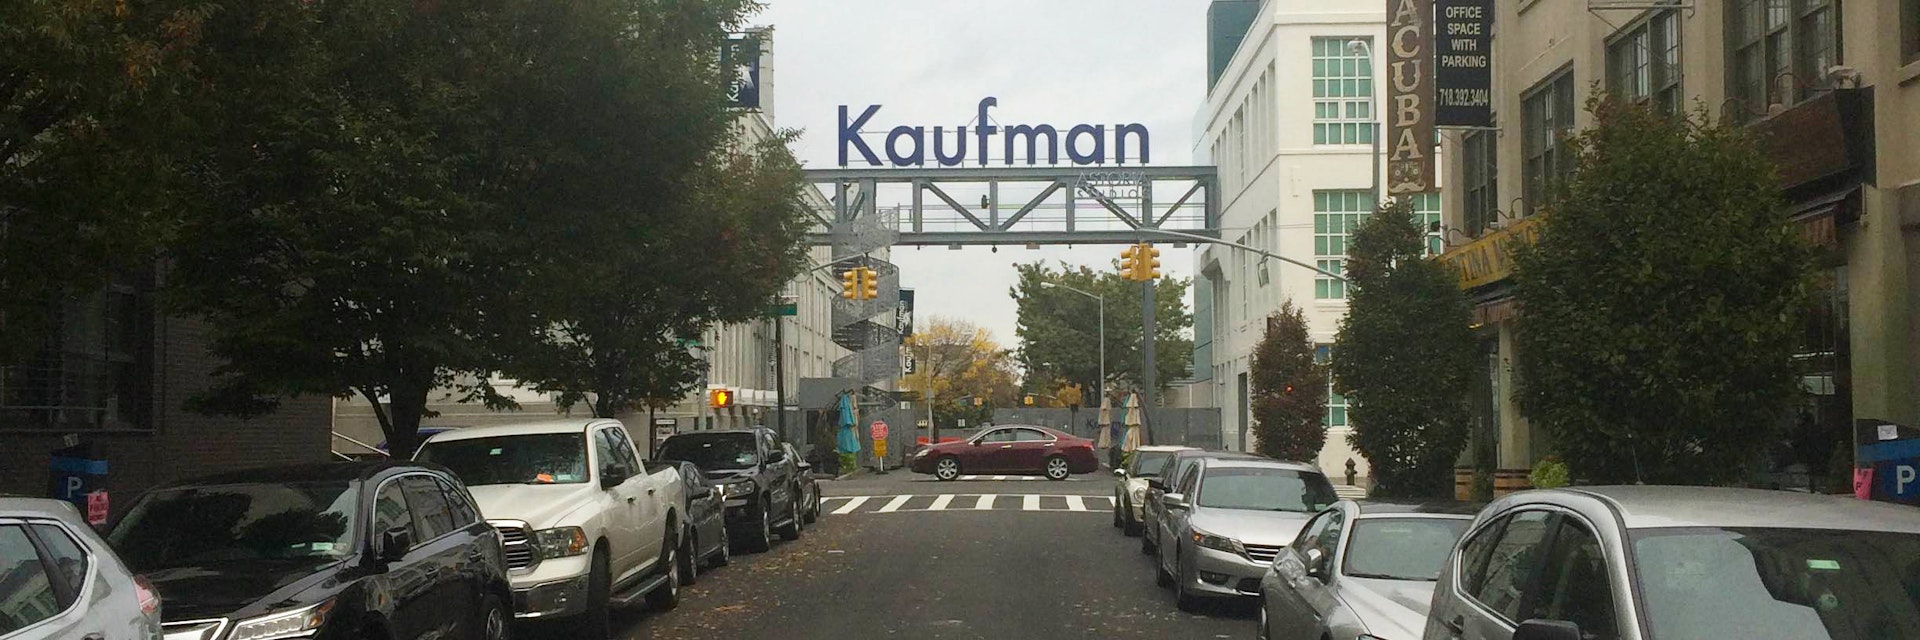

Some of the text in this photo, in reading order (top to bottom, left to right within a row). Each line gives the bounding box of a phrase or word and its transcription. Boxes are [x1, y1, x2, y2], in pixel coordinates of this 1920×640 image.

[1445, 6, 1482, 19] OFFICE
[1447, 23, 1481, 35] SPACE
[1451, 39, 1477, 51] WITH
[1441, 55, 1487, 68] PARKING
[1440, 88, 1489, 107] 718.392.3404
[837, 96, 1150, 167] Kaufman
[1075, 171, 1152, 187] ASTORIA
[67, 476, 83, 498] P
[1896, 465, 1916, 494] P
